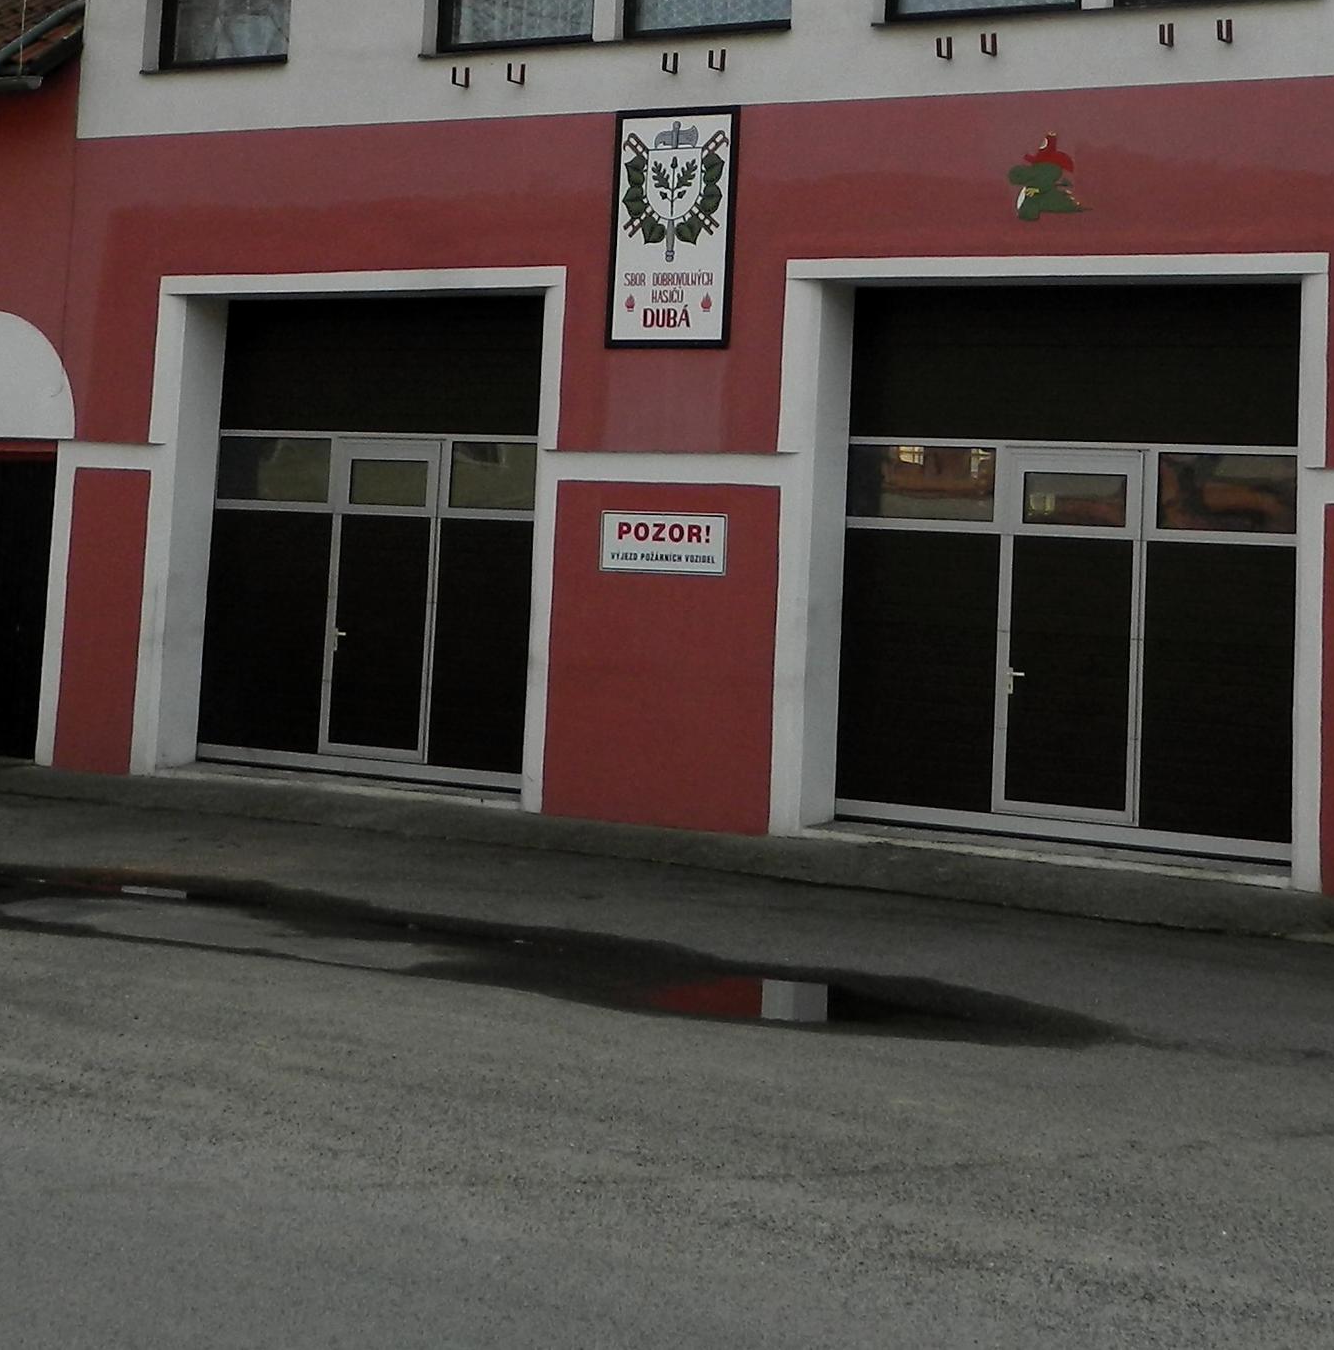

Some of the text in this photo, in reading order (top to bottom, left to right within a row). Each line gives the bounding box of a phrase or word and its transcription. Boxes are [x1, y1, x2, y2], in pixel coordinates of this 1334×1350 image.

[623, 269, 714, 287] SBOR DOBROVOLNÝCH
[651, 287, 684, 304] HASIČŮ
[642, 304, 691, 328] DUBÁ
[618, 521, 711, 544] POZOR!
[610, 550, 716, 564] VÝJEZD POŽÁRNÍCH VOZIDEL
